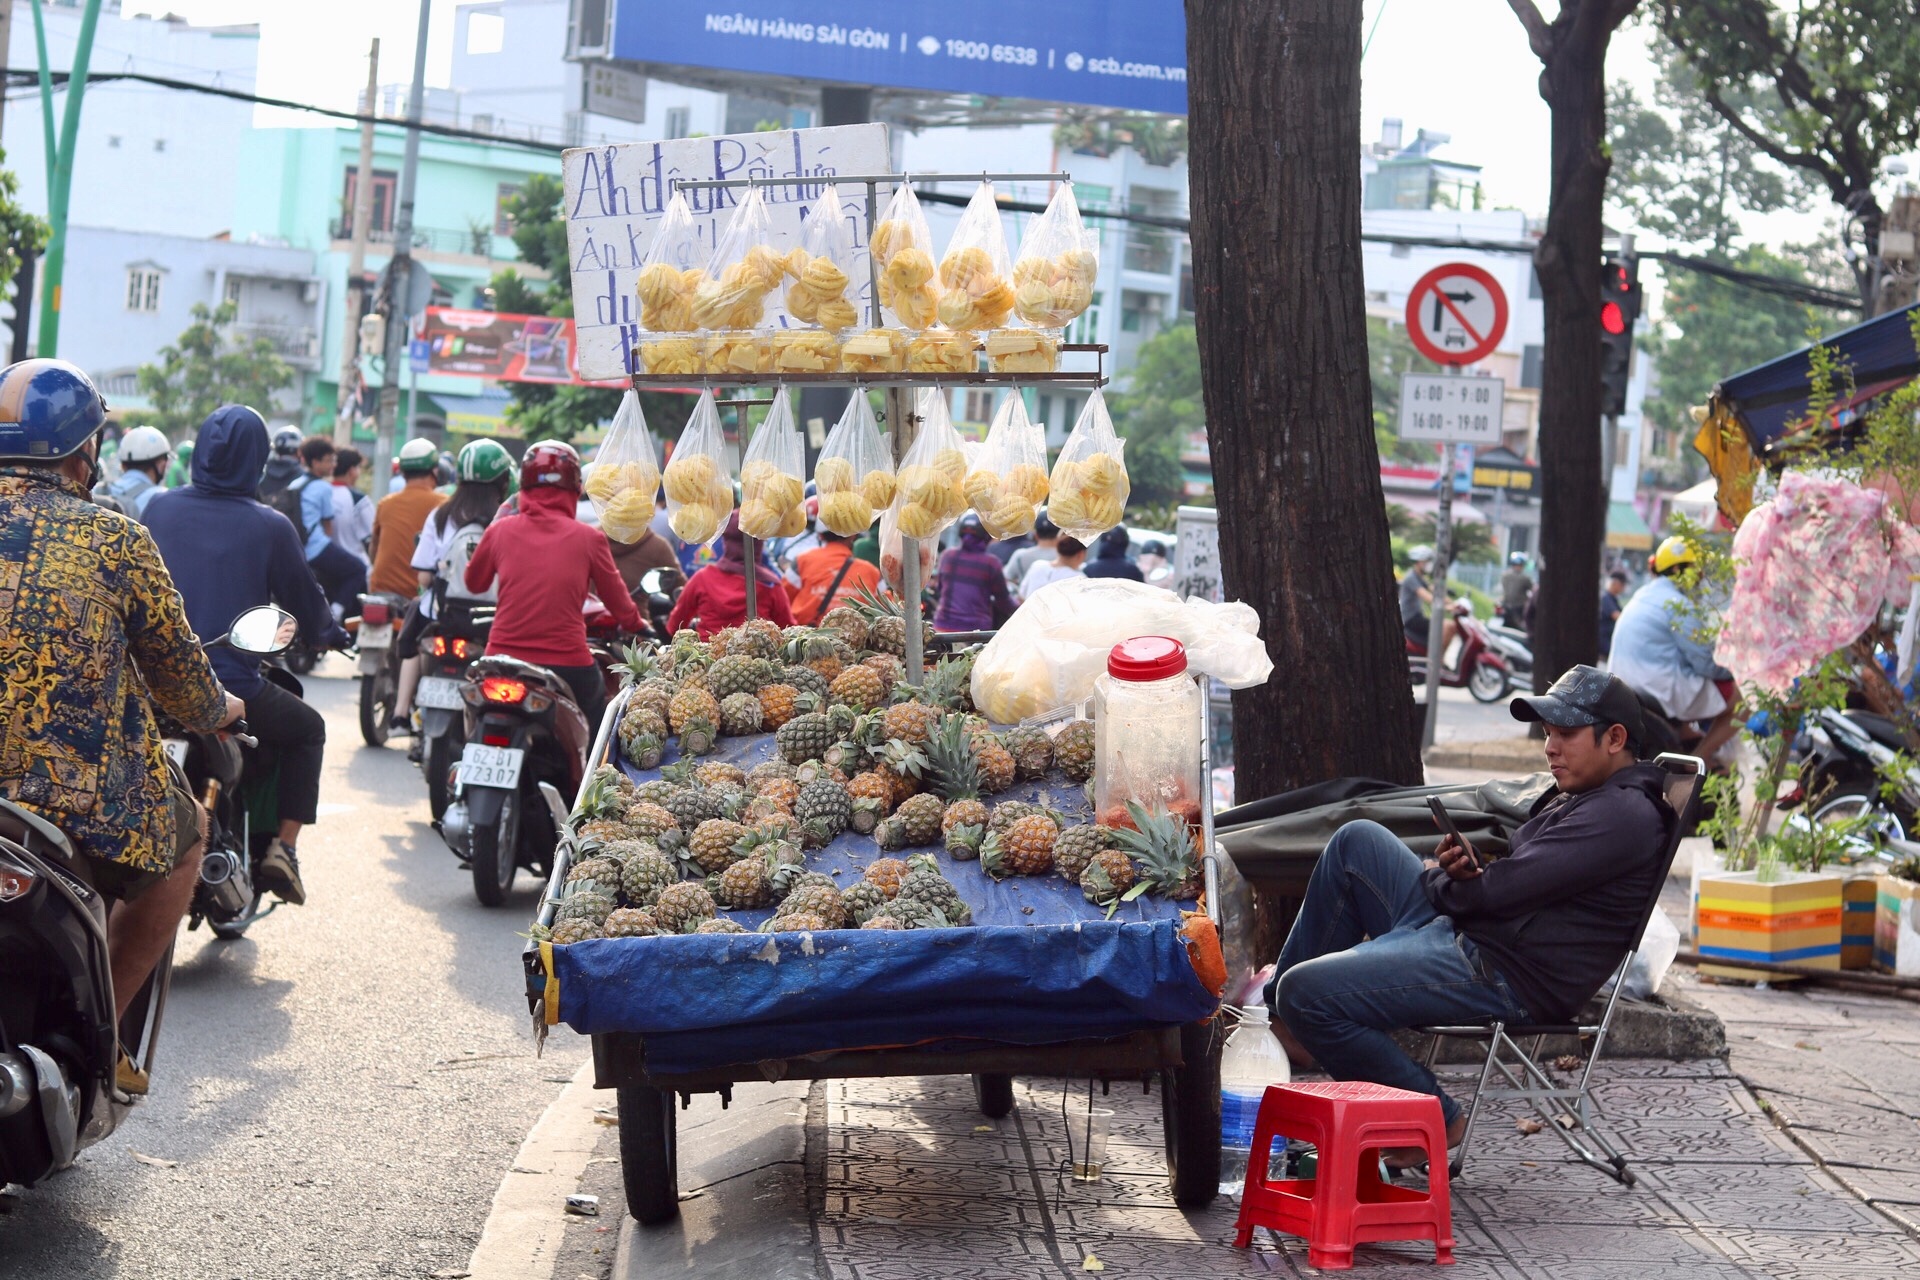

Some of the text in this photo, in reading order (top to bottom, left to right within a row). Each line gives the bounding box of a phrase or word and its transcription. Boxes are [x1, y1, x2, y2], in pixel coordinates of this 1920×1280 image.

[705, 13, 1187, 82] NGÂN HÀNG SÀI GÒN 1900 6538 scb.com.vn
[1414, 385, 1443, 401] 6:00
[1461, 386, 1490, 404] 9:00
[1413, 412, 1443, 429] 16:00
[1458, 414, 1488, 431] 19:00
[472, 748, 512, 767] 62-B1
[463, 765, 516, 785] 723.07
